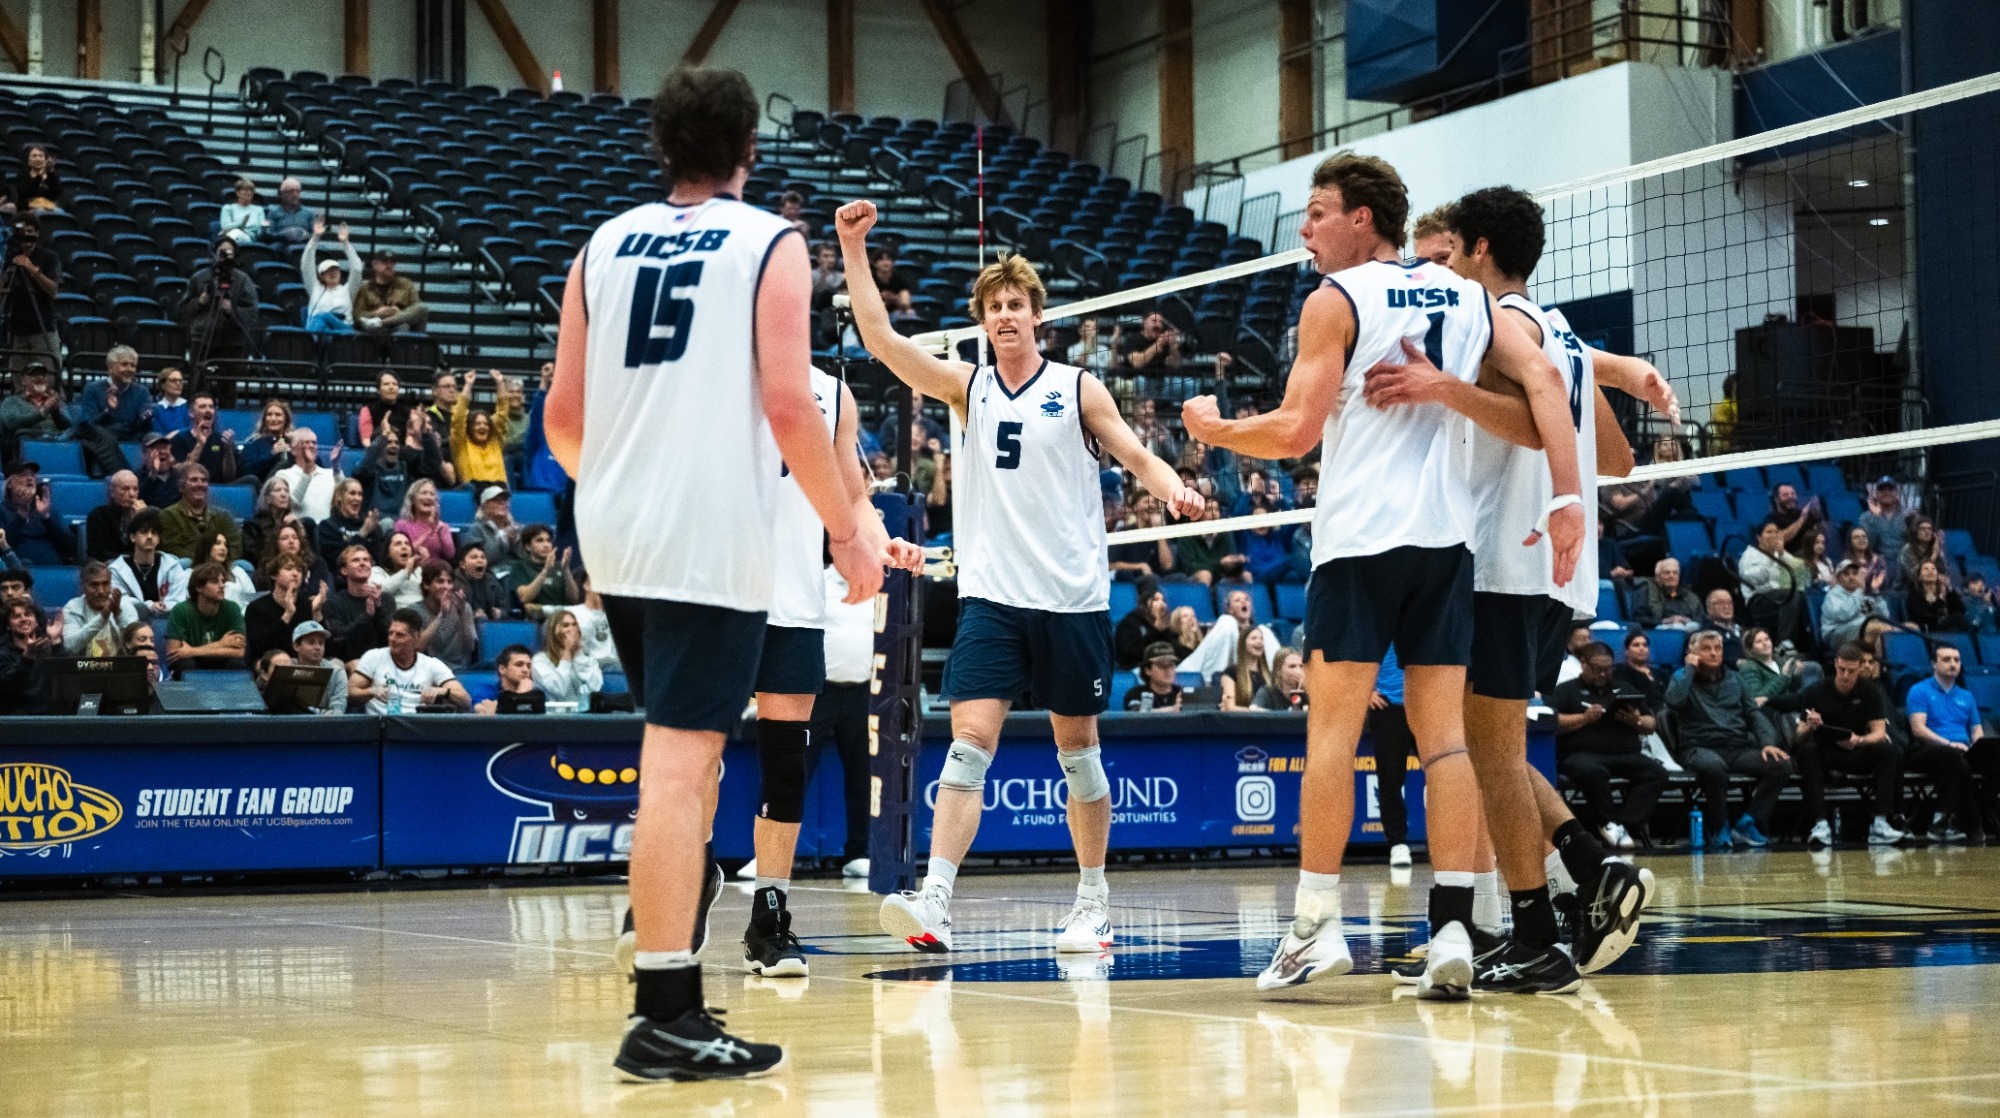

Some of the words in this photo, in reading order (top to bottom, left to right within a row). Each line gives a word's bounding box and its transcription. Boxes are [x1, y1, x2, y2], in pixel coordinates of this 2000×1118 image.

[615, 229, 731, 259] UCSB
[625, 260, 705, 368] 15
[995, 421, 1023, 470] 5
[1093, 677, 1103, 697] 5
[1268, 757, 1287, 773] FOR
[0, 765, 74, 813] UCHO
[136, 788, 232, 817] STUDENT
[236, 787, 277, 816] FAN
[281, 786, 354, 815] GROUP
[0, 787, 118, 840] TION
[135, 819, 158, 829] JOIN
[161, 819, 180, 829] THE
[184, 818, 211, 828] TEAM
[213, 817, 249, 828] ONLINE
[252, 817, 265, 827] AT
[266, 816, 353, 828] UCSBgauchos.com
[1012, 815, 1020, 825] A
[1024, 813, 1055, 825] FUND
[1109, 811, 1177, 824] ORTUNITIES
